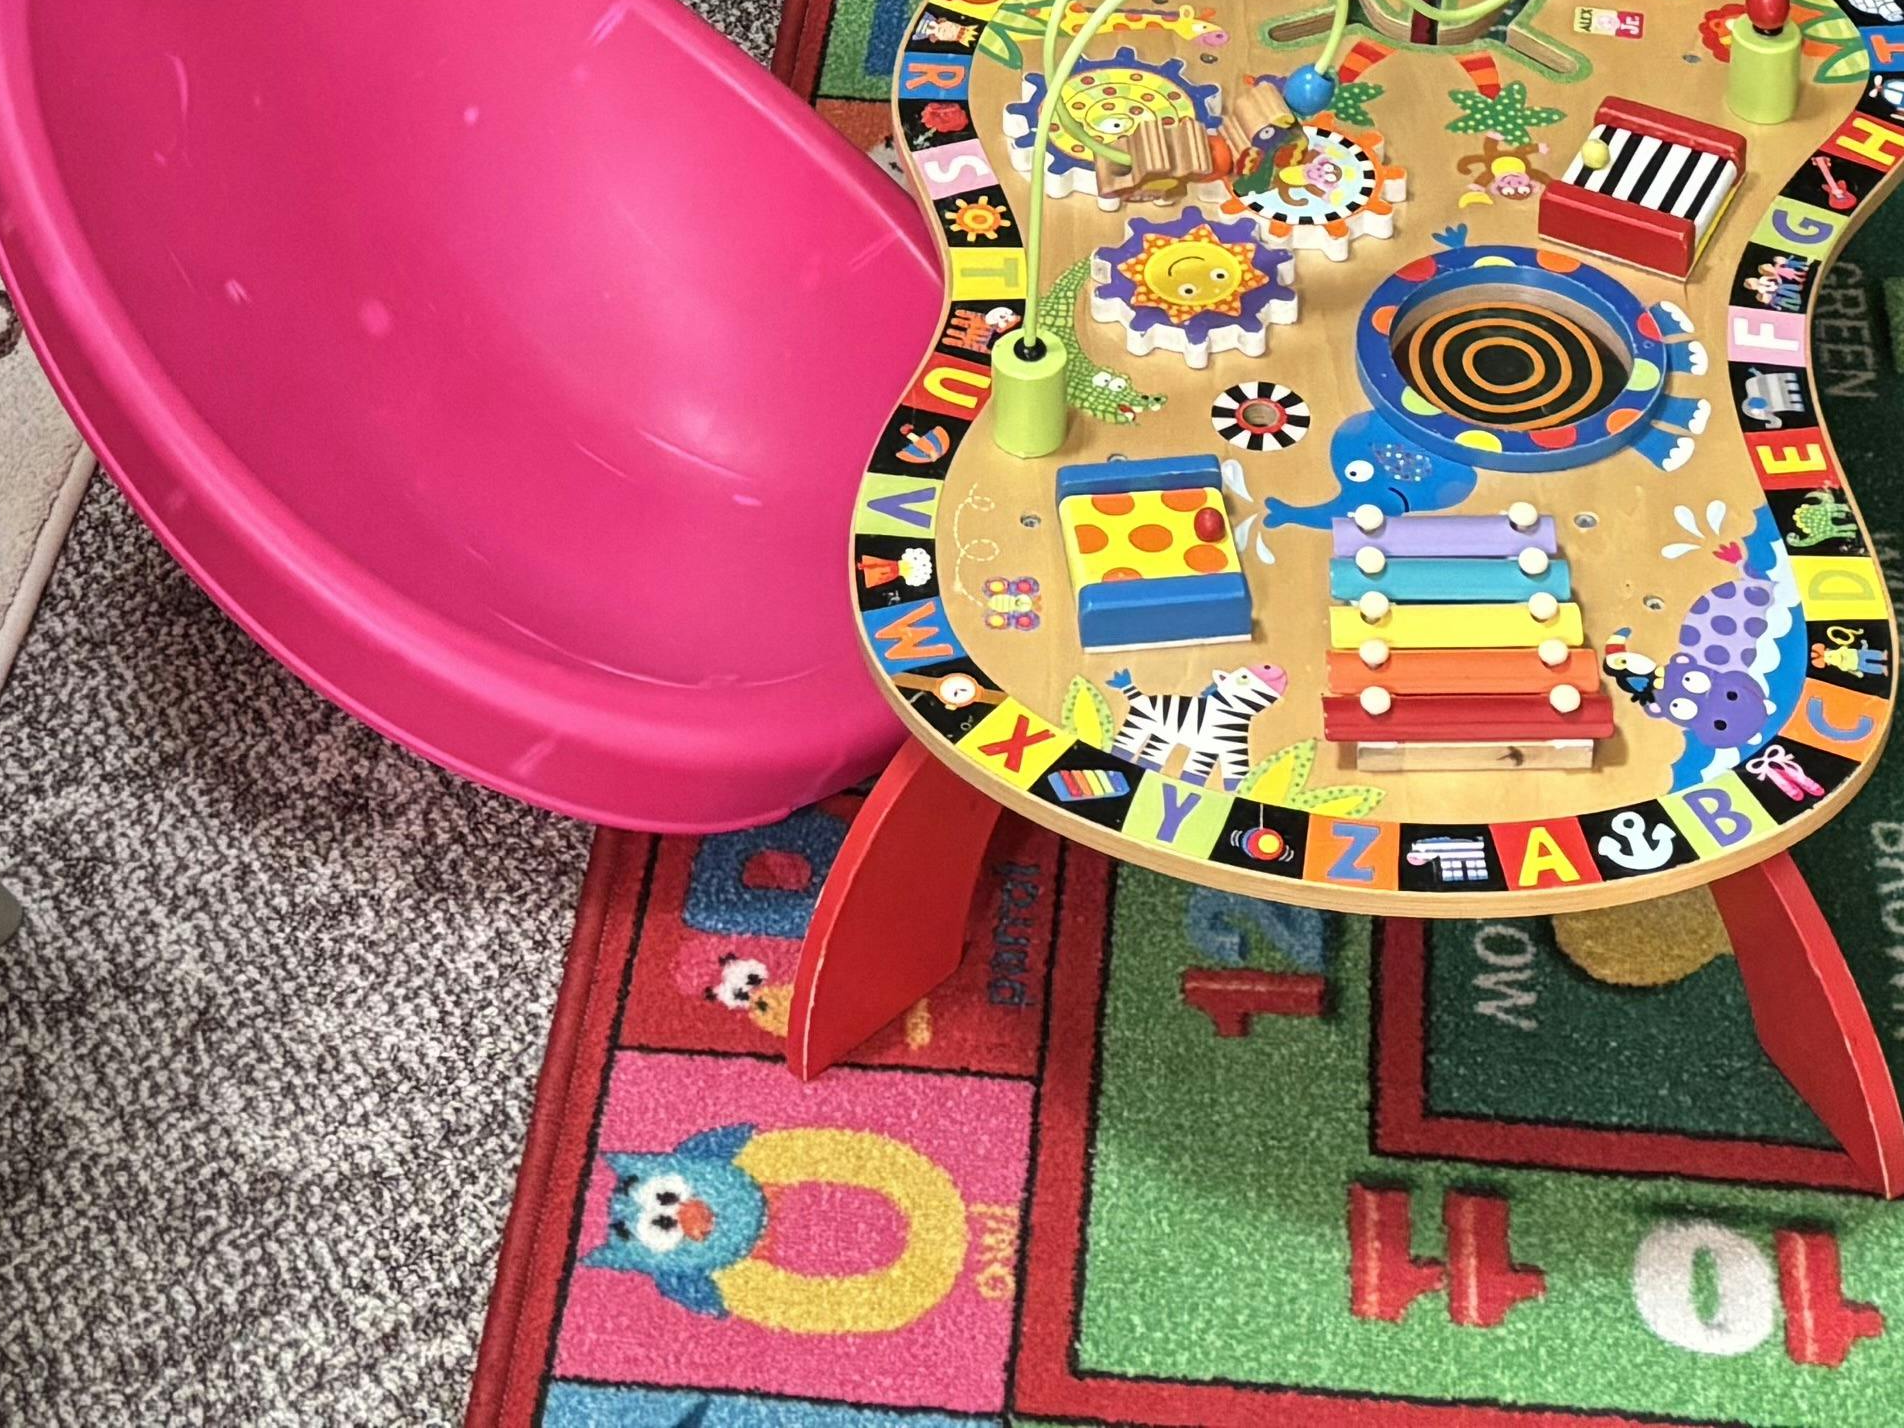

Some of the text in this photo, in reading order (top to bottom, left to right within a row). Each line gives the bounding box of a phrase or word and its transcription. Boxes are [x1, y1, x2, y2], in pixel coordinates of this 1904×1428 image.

[905, 62, 966, 90] R
[923, 155, 990, 185] S
[1771, 208, 1834, 246] G
[960, 257, 1019, 288] T
[1732, 316, 1802, 352] F
[923, 366, 992, 409] U
[1756, 443, 1827, 475] E
[866, 485, 937, 529] V
[1808, 569, 1876, 602] D
[874, 600, 954, 661] W
[977, 713, 1057, 774] X
[1806, 696, 1875, 742] C
[1156, 783, 1202, 843] Y
[1682, 788, 1753, 848] B
[1327, 822, 1381, 882] Z
[1518, 826, 1582, 887] A
[986, 861, 1040, 1009] parrot
[714, 1127, 969, 1334] O
[967, 1201, 1019, 1300] owl
[1343, 1182, 1546, 1328] 11
[1631, 1219, 1886, 1370] 10
